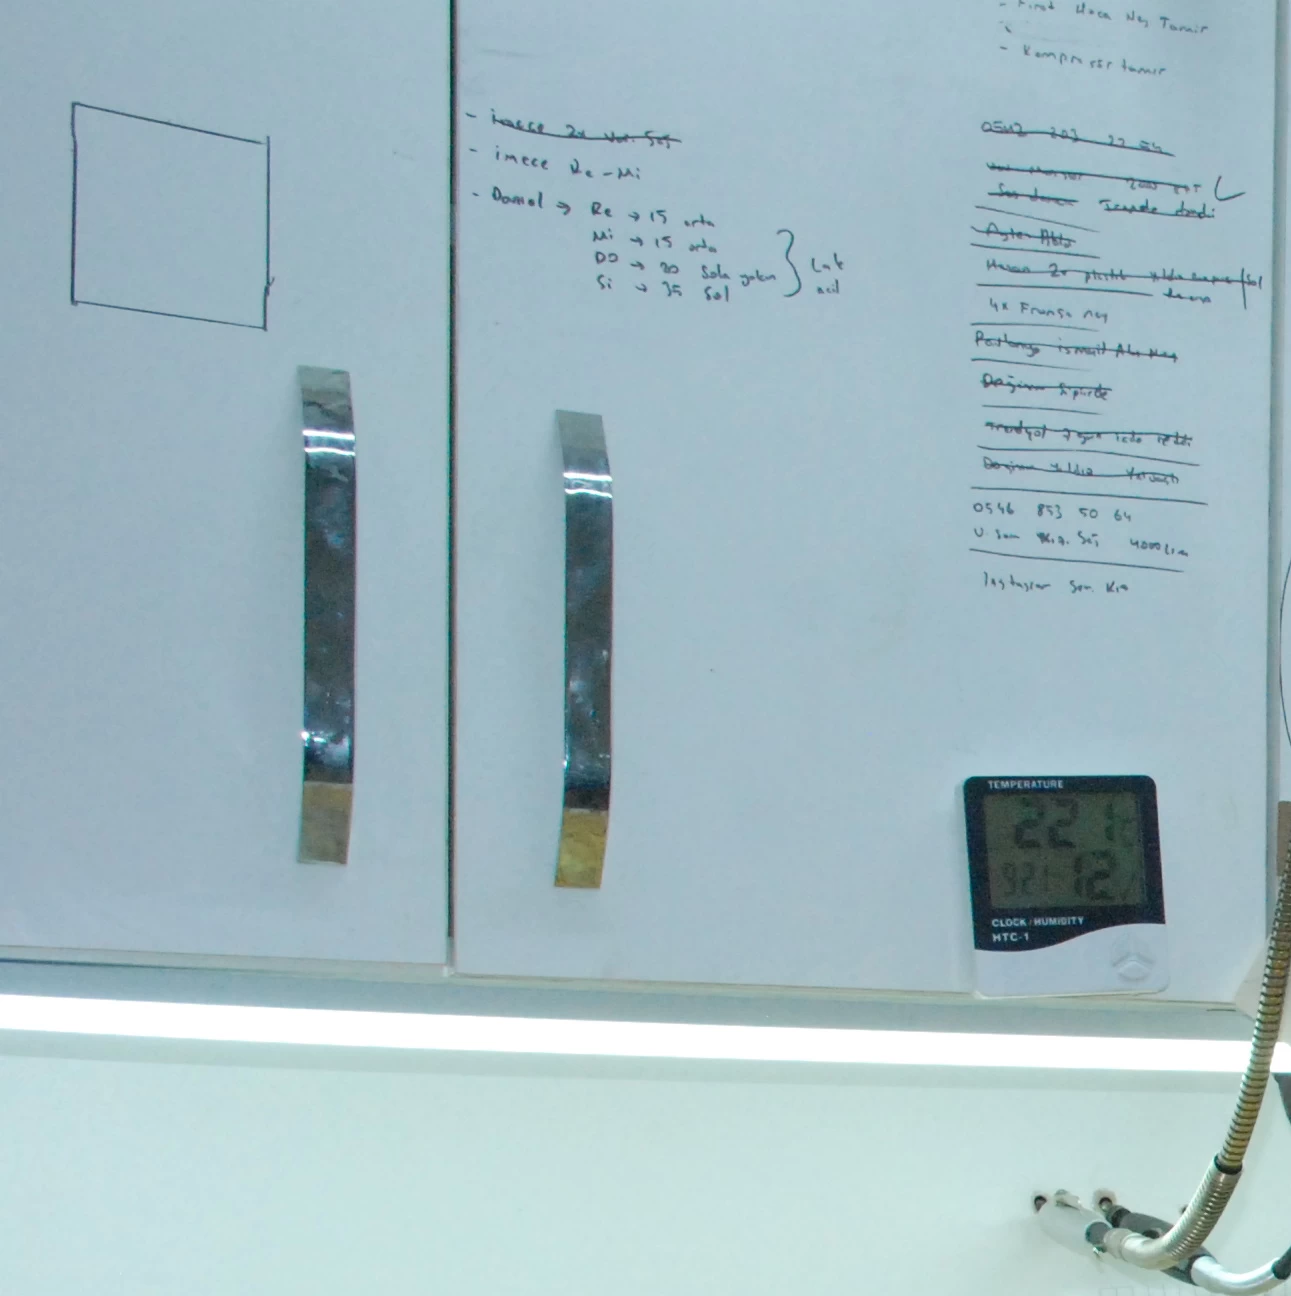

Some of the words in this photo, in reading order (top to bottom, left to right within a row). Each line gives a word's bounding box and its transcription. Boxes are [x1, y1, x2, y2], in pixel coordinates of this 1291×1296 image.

[988, 779, 1064, 789] TEMPERATURE
[991, 918, 1027, 927] CLOCK
[1034, 916, 1084, 926] HUMIDITY
